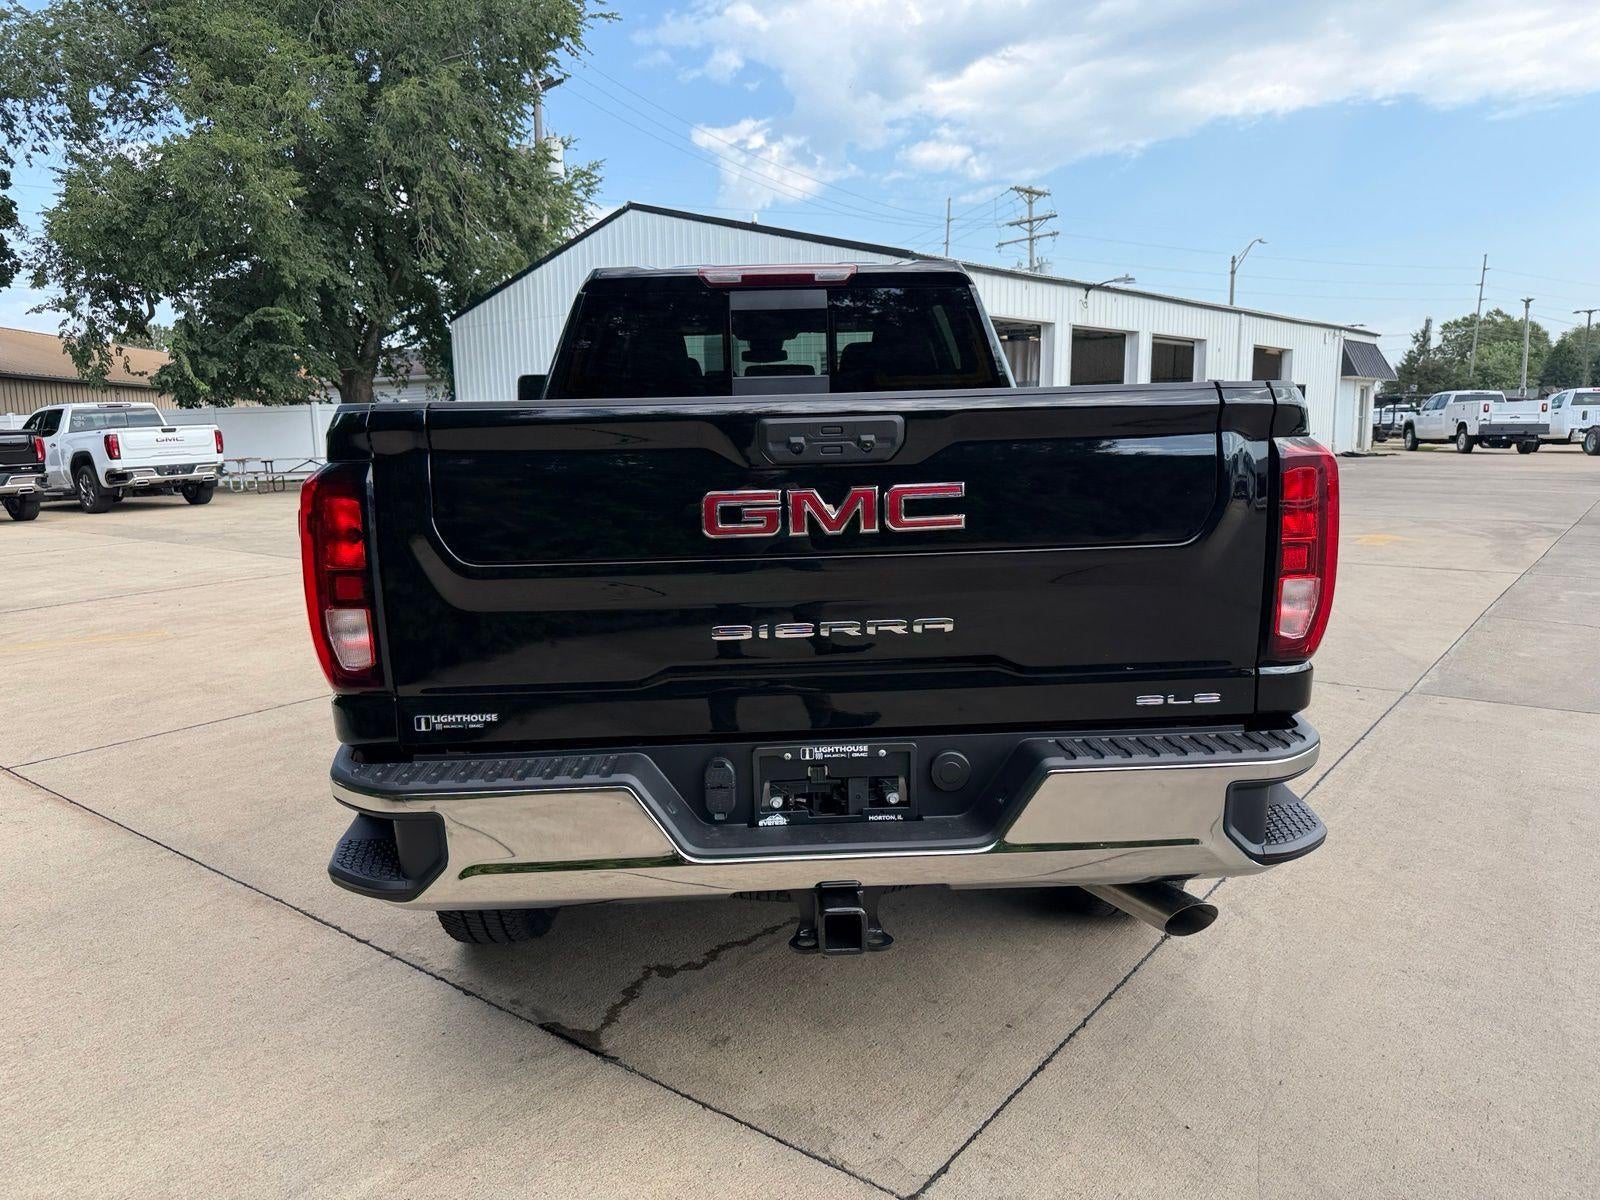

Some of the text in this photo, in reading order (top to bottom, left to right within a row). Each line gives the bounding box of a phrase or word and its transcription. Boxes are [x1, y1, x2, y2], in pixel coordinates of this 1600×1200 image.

[702, 482, 966, 539] GMC
[711, 617, 954, 641] SIERRA
[1135, 693, 1221, 706] SLE
[432, 713, 499, 723] LIGHTHOUSE
[814, 745, 869, 753] LIGHTHOUSE
